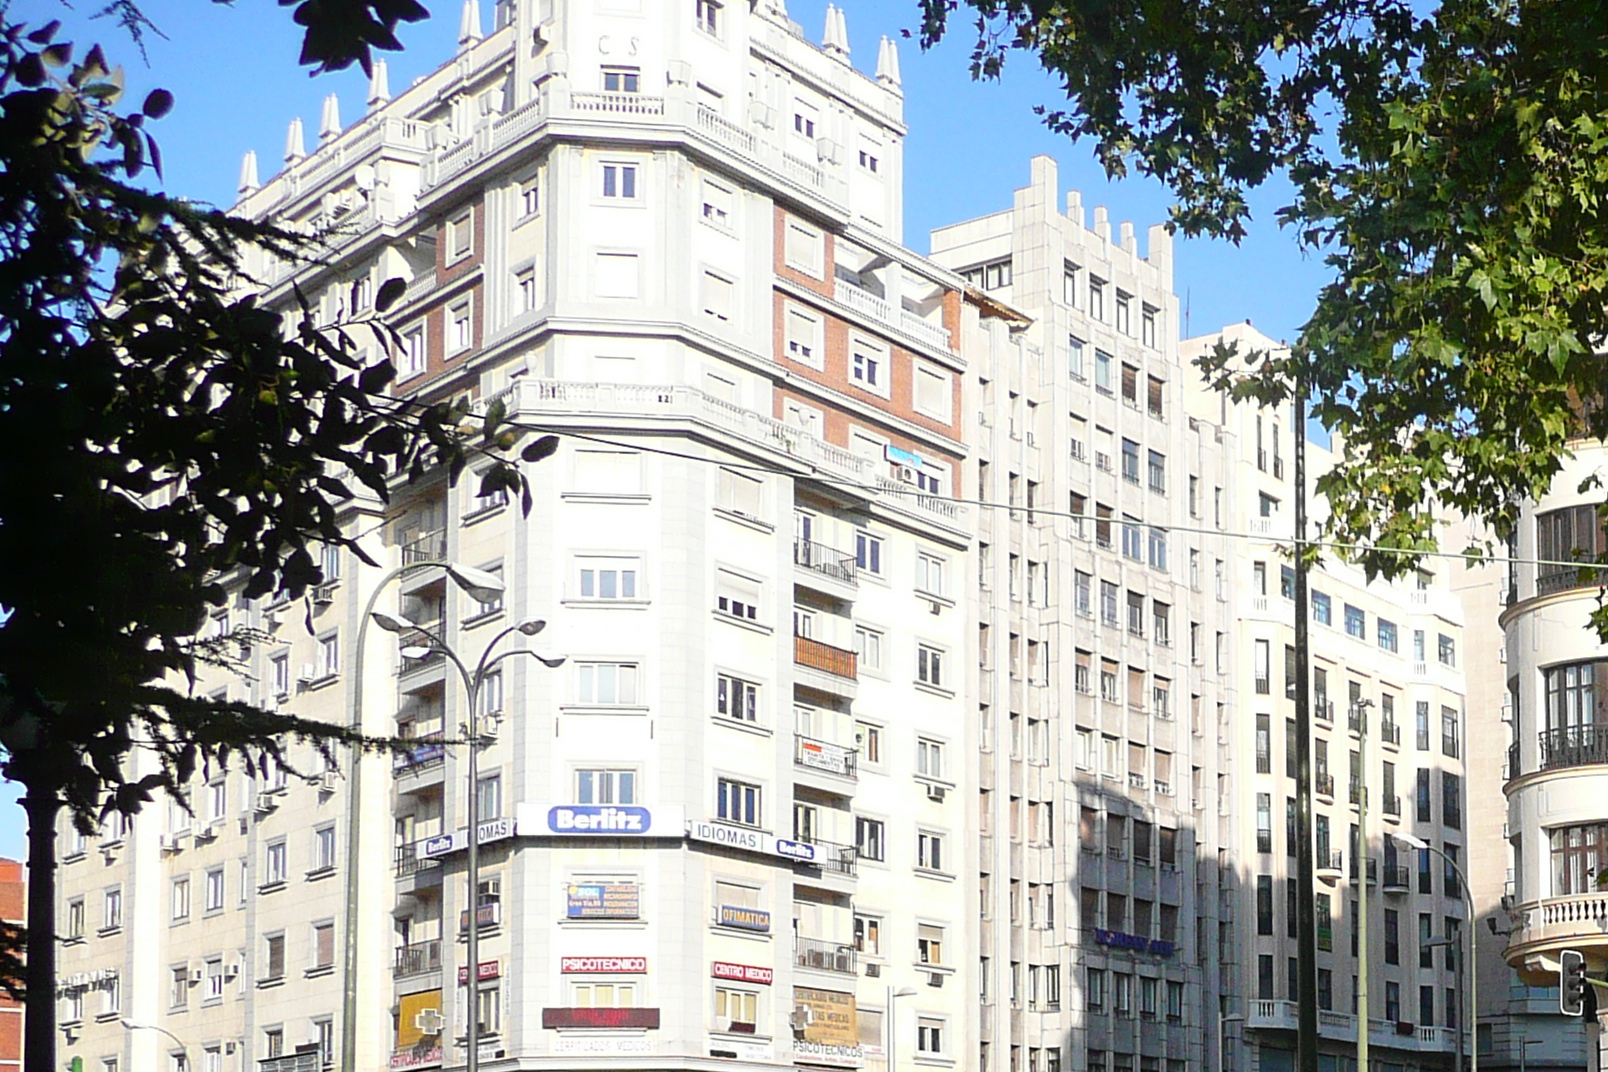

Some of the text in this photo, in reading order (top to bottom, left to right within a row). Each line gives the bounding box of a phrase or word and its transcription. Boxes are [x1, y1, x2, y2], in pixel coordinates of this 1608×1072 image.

[555, 809, 642, 830] Berlitz
[478, 821, 507, 842] OMAS
[698, 824, 813, 859] IDIOMAS Berlitz
[427, 837, 451, 855] Berlitz
[723, 906, 769, 927] OFIMATICA
[562, 958, 645, 972] PSICOTECNICO
[715, 963, 772, 982] CENTRO MEDICO
[792, 1040, 863, 1058] PSICOTECNICOS
